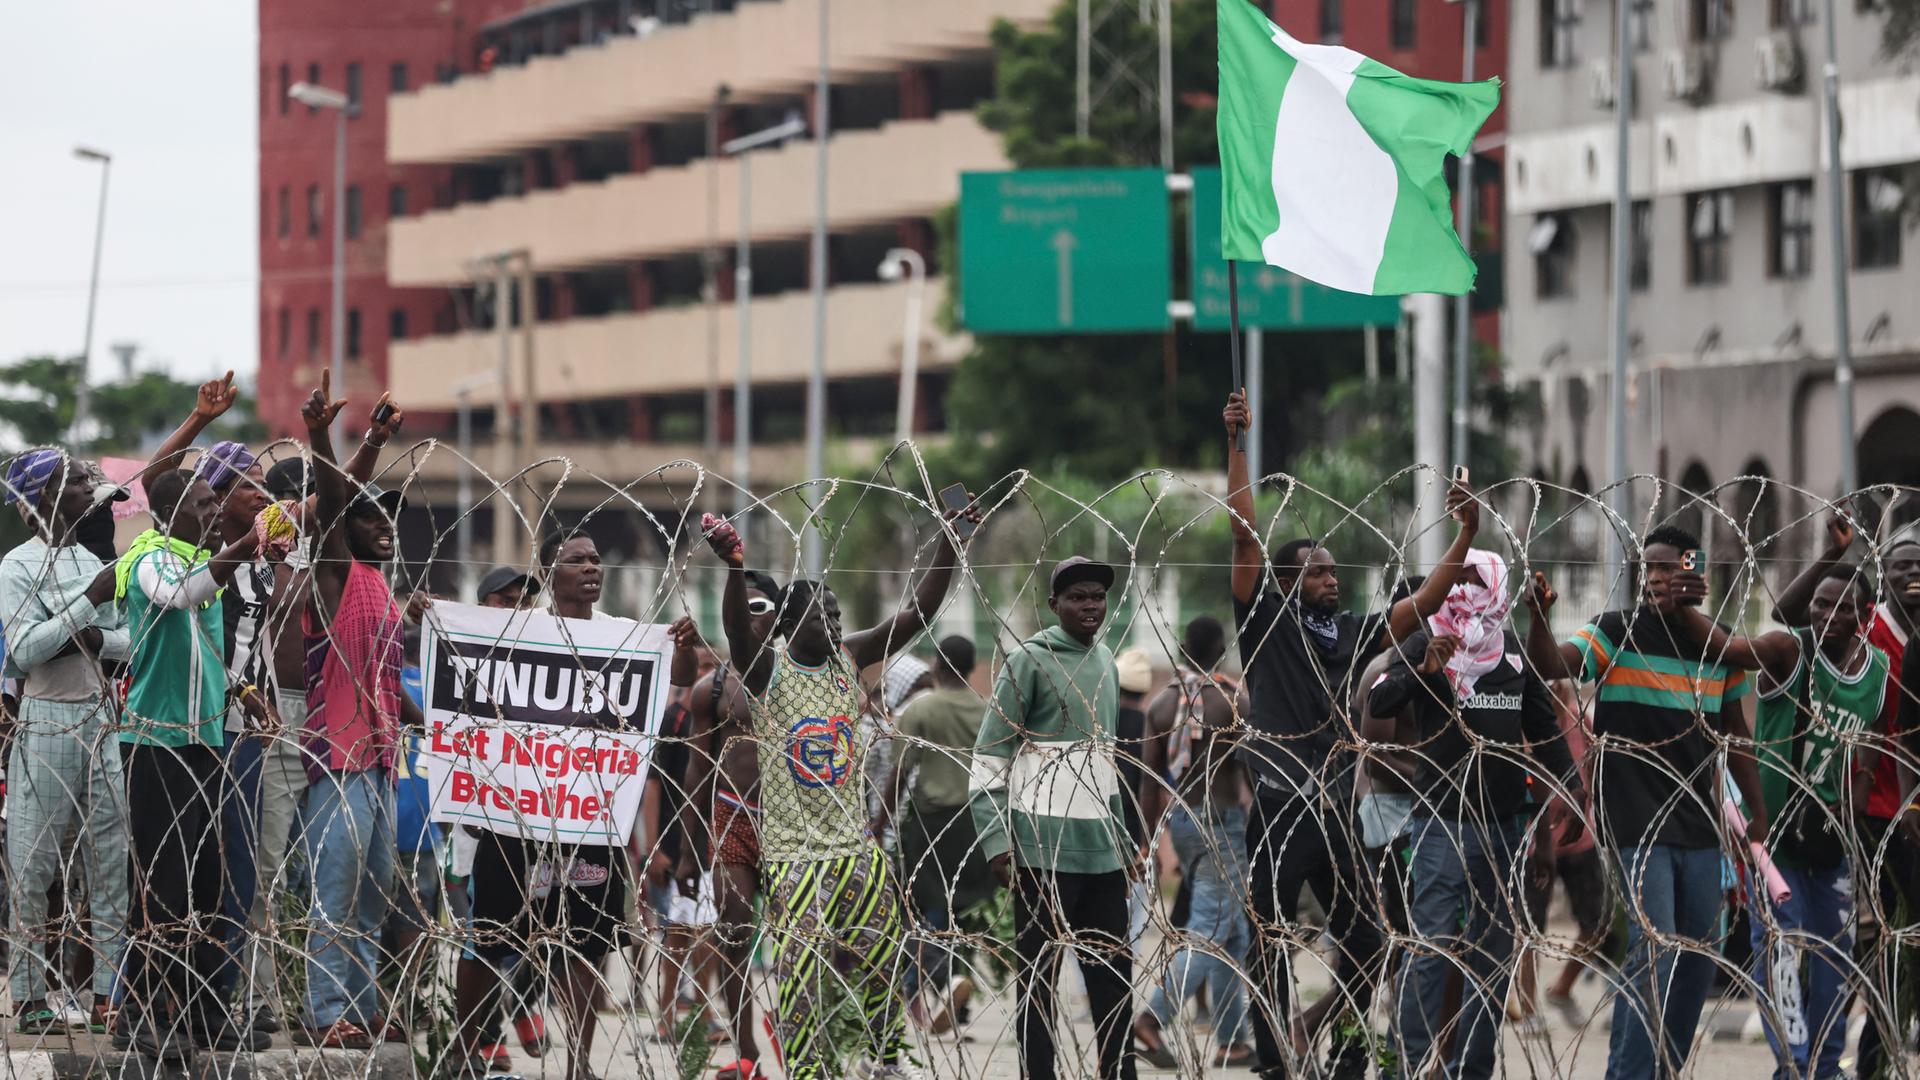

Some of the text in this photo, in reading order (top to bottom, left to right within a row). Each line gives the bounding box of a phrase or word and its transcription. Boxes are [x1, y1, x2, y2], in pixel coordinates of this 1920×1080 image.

[447, 655, 643, 717] TINUBU
[1466, 692, 1523, 710] utxaban
[1807, 700, 1866, 747] OSTON
[431, 721, 490, 760] Let
[502, 731, 639, 777] Nigeria
[451, 771, 613, 821] Breathe!
